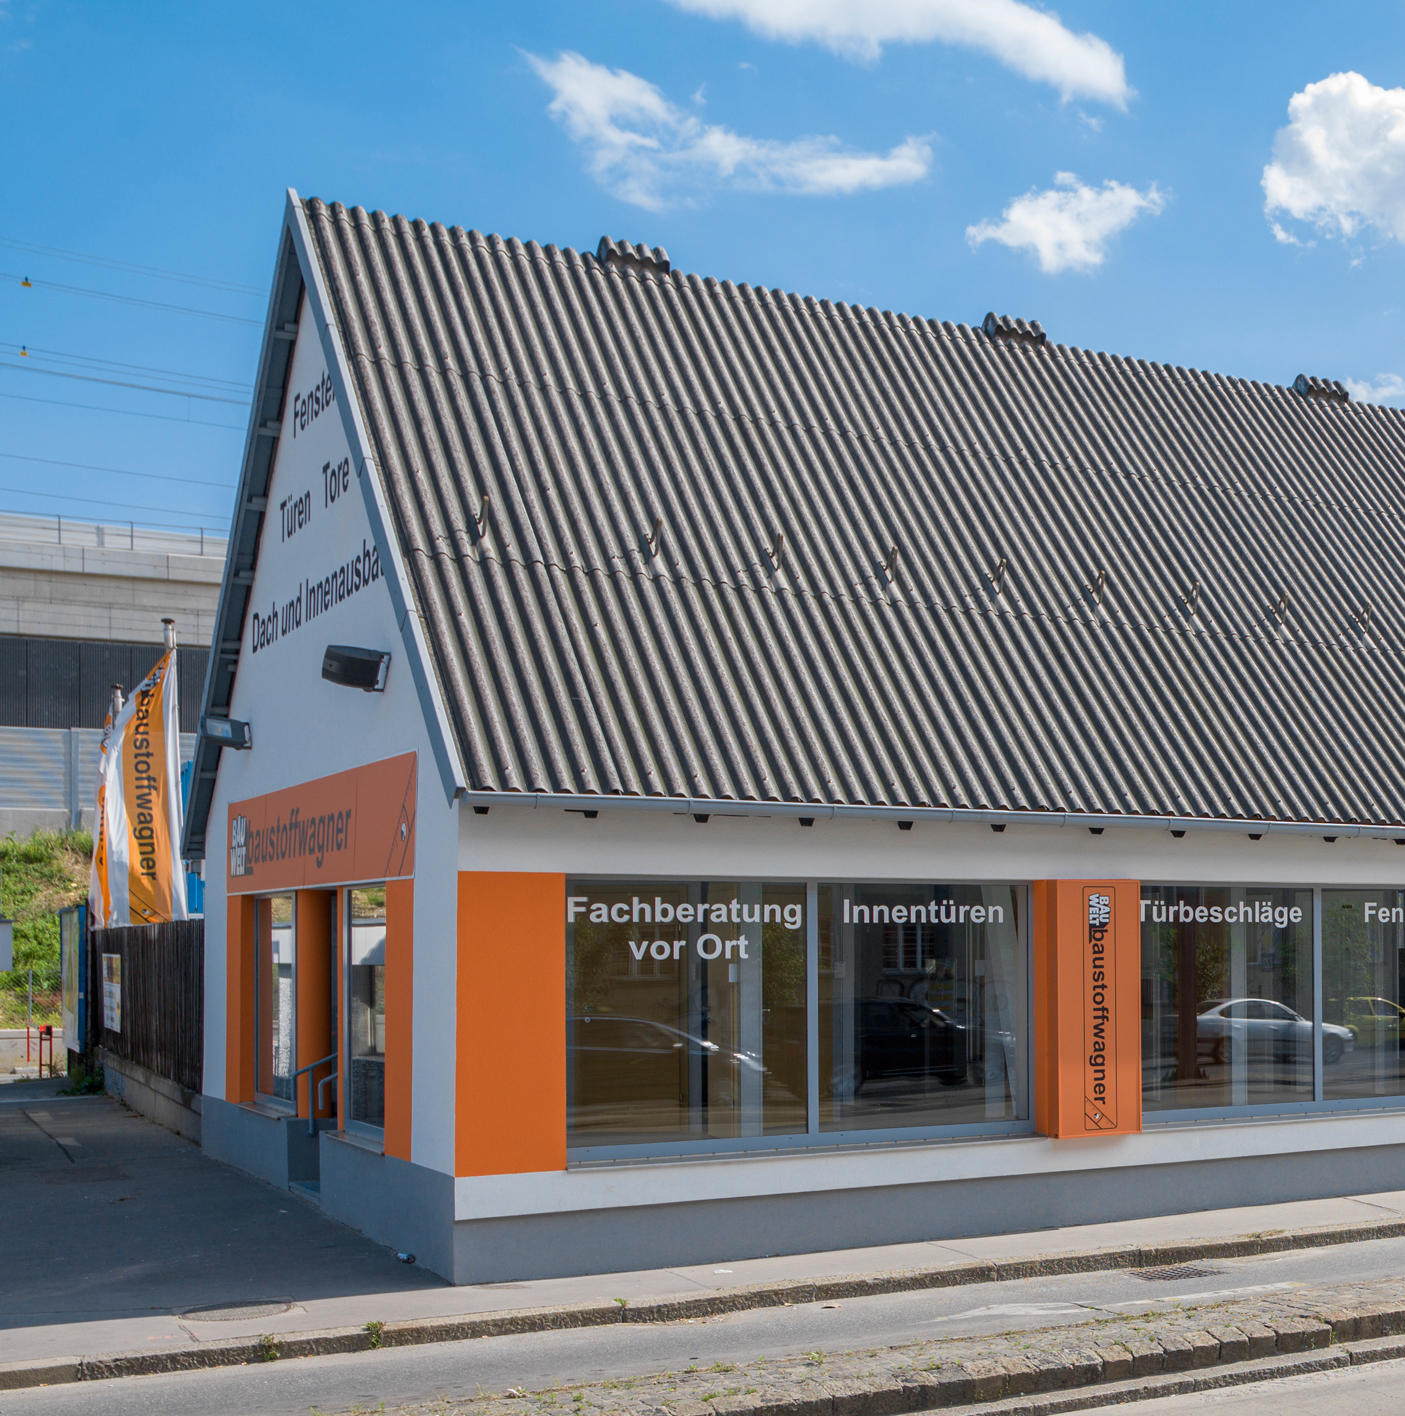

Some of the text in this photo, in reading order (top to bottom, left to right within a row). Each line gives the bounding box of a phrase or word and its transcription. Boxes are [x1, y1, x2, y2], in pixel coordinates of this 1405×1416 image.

[293, 369, 337, 440] Fenste
[280, 456, 350, 542] Türen Tore
[252, 601, 279, 654] Dach
[281, 582, 303, 637] und
[133, 690, 158, 880] baustoffwagner
[246, 807, 352, 868] baustoffwagner
[567, 896, 802, 930] Fachberatung
[843, 898, 1005, 925] Innentüren
[1088, 893, 1100, 926] WELT
[1099, 895, 1112, 923] BAU
[1140, 900, 1303, 928] Türbeschläge
[629, 933, 750, 961] vor Ort
[1089, 927, 1109, 1105] baustoffwagner
